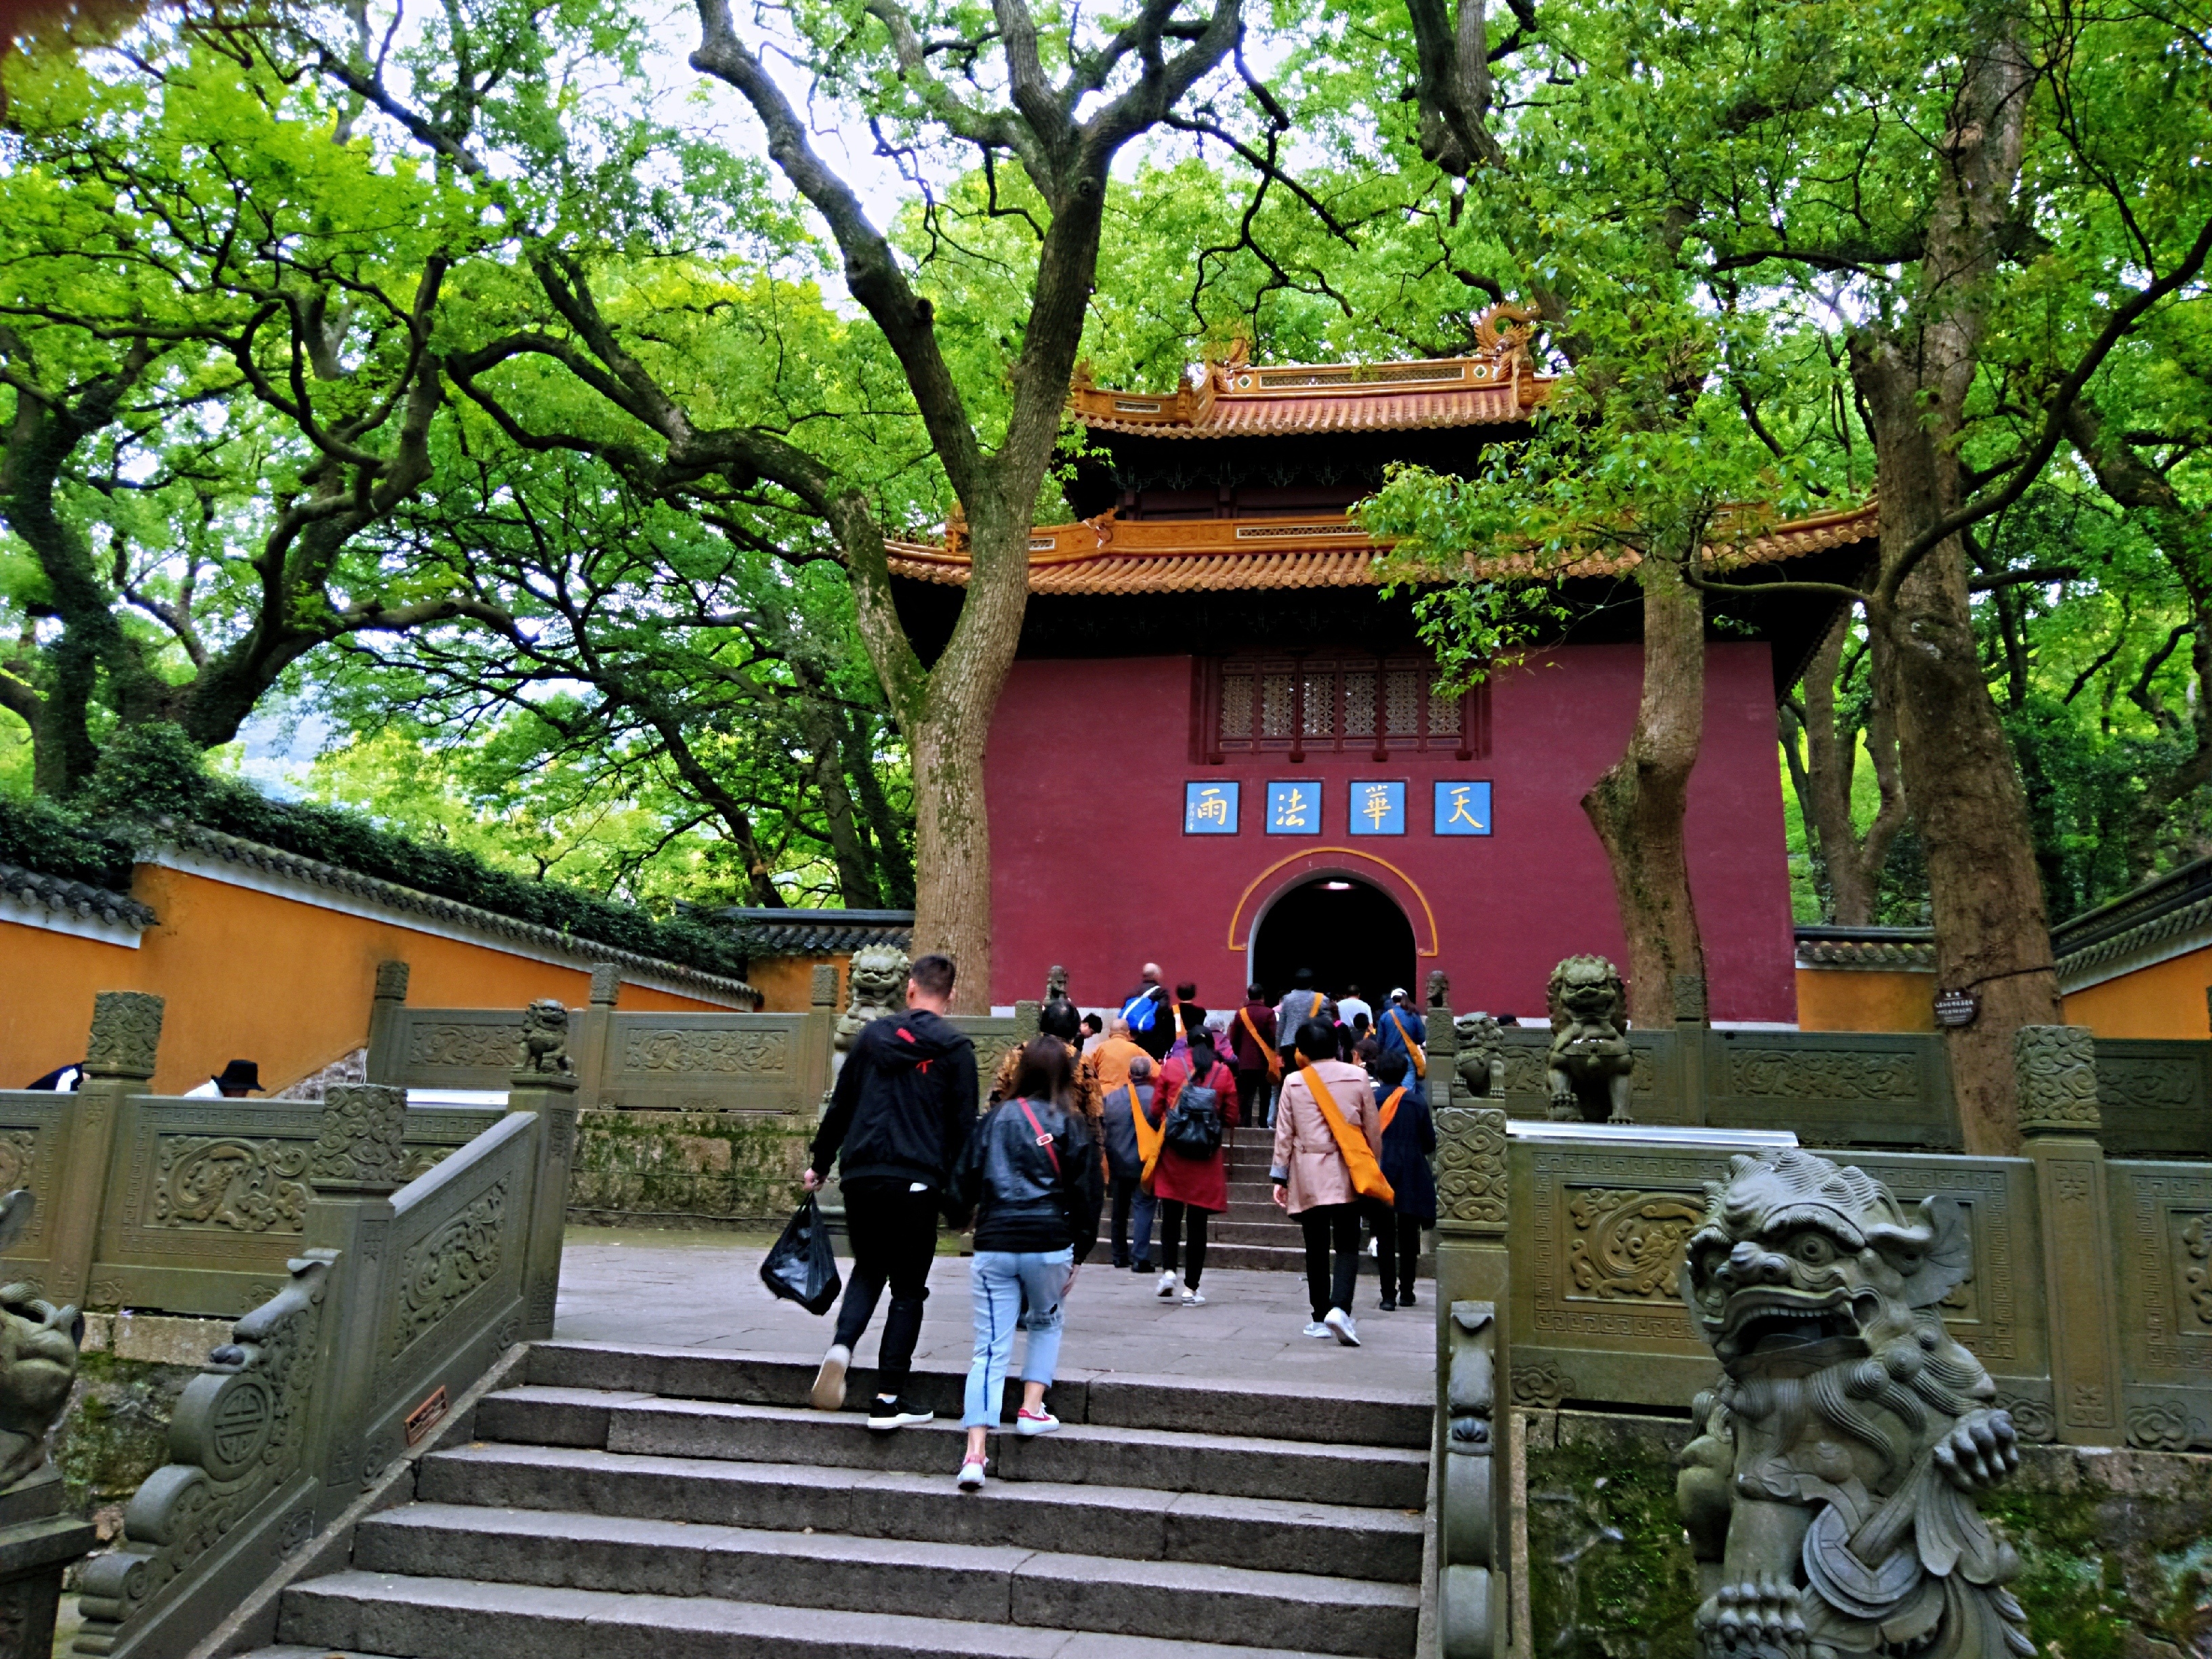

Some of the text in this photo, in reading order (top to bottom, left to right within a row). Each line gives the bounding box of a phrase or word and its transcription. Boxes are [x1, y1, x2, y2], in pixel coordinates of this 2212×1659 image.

[1197, 788, 1227, 825] 雨
[1276, 787, 1307, 826] 法
[1363, 784, 1392, 830] 華
[1448, 786, 1484, 828] 天
